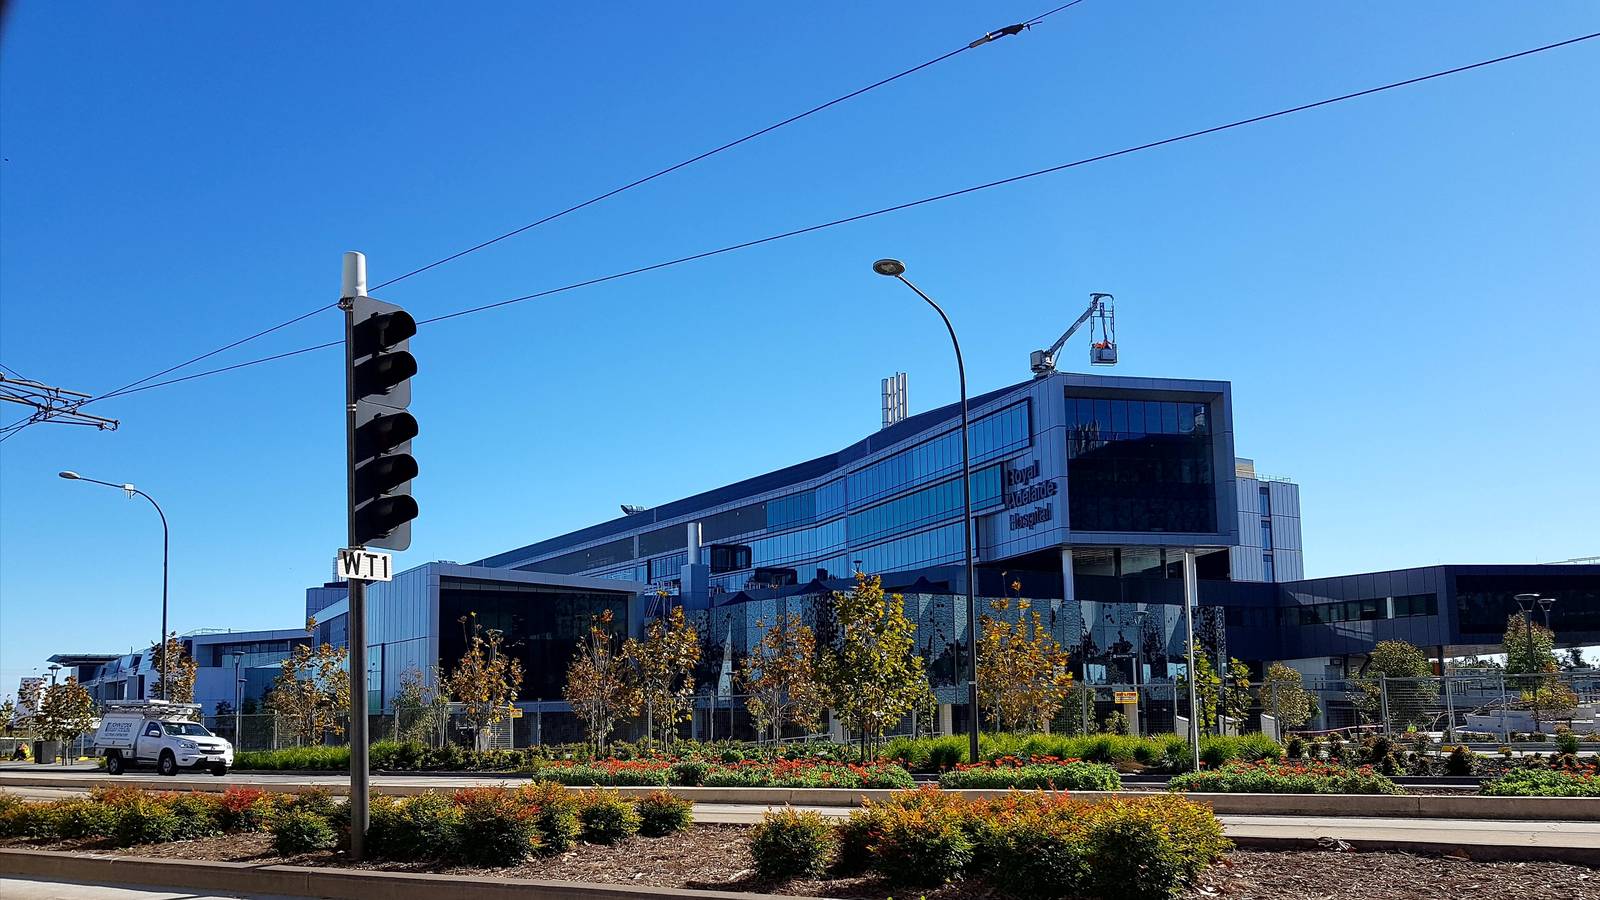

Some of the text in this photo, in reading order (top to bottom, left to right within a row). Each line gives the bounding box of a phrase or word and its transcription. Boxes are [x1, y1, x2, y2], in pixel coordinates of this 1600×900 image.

[1008, 460, 1040, 486] Royal
[1009, 480, 1057, 509] Adelaide
[1009, 503, 1052, 531] Hospital
